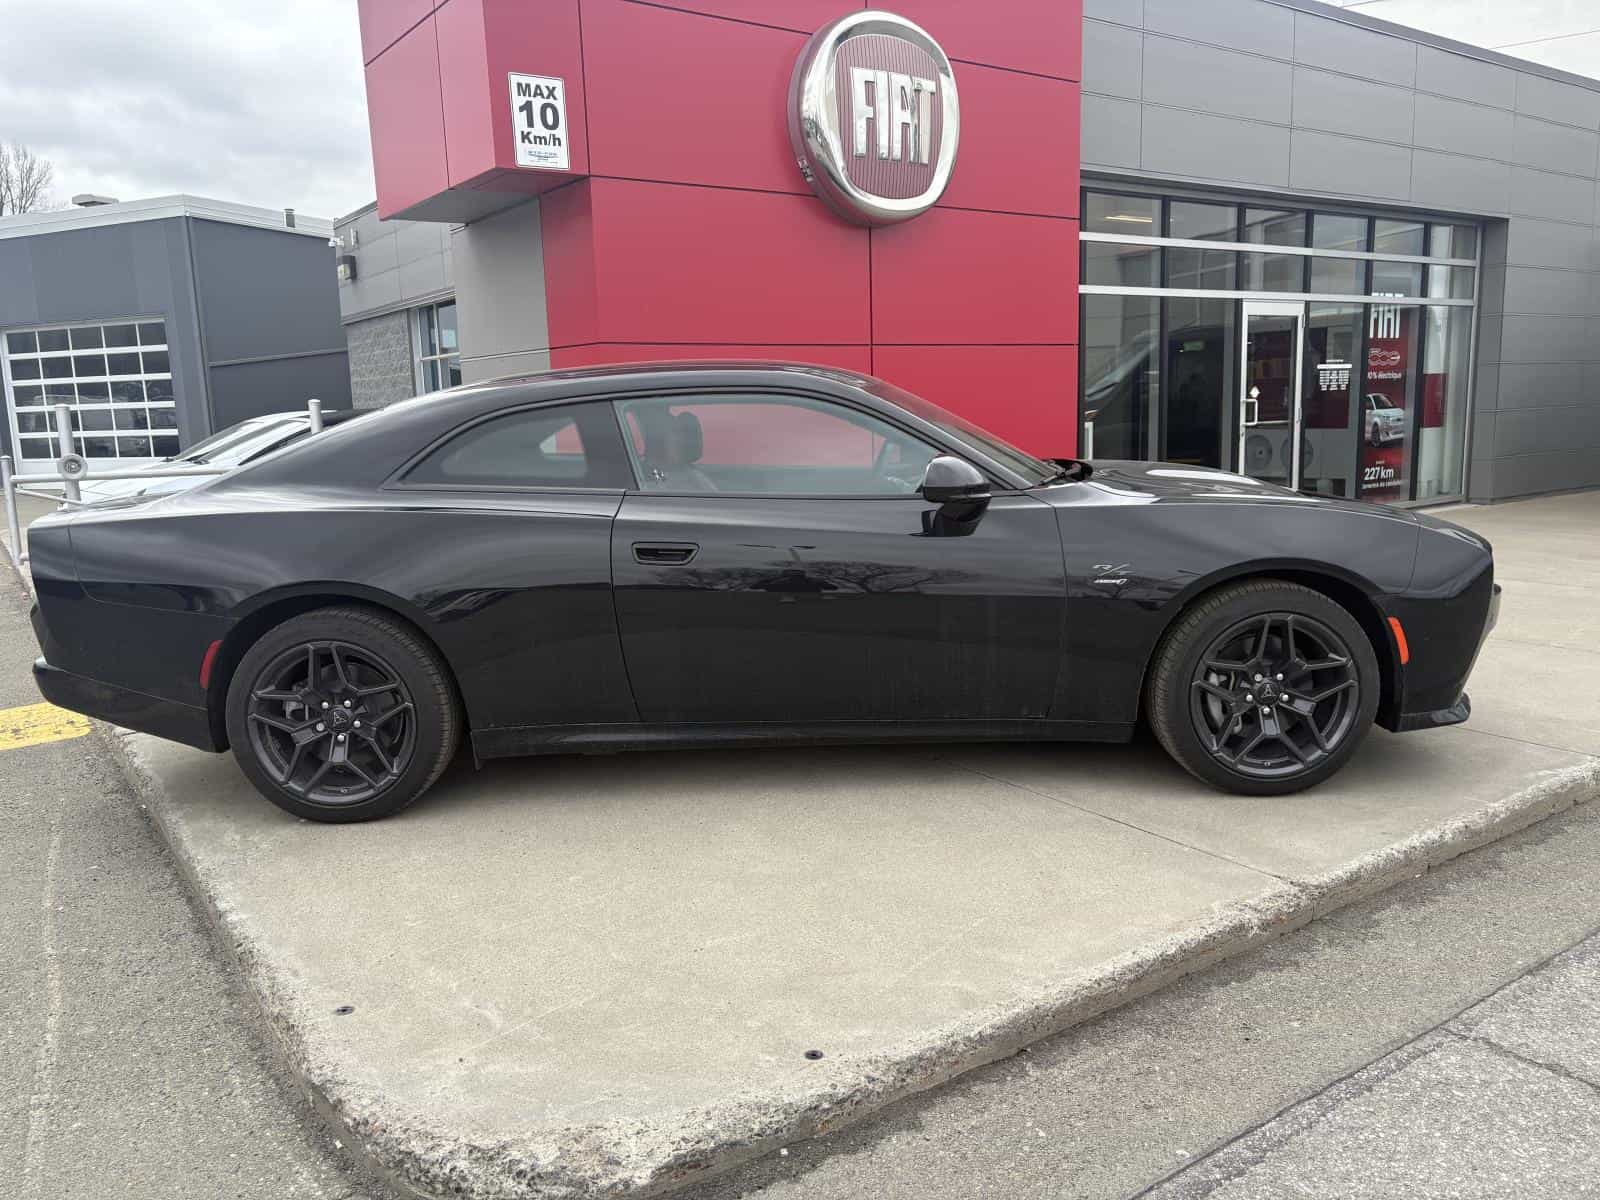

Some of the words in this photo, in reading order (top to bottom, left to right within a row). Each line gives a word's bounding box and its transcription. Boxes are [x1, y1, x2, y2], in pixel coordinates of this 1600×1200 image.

[516, 82, 558, 101] MAX
[518, 100, 560, 131] 10
[851, 66, 937, 165] FIAT
[520, 130, 562, 147] Km/h
[1369, 292, 1404, 339] FIAT
[1363, 467, 1381, 481] 227
[1380, 466, 1395, 480] km
